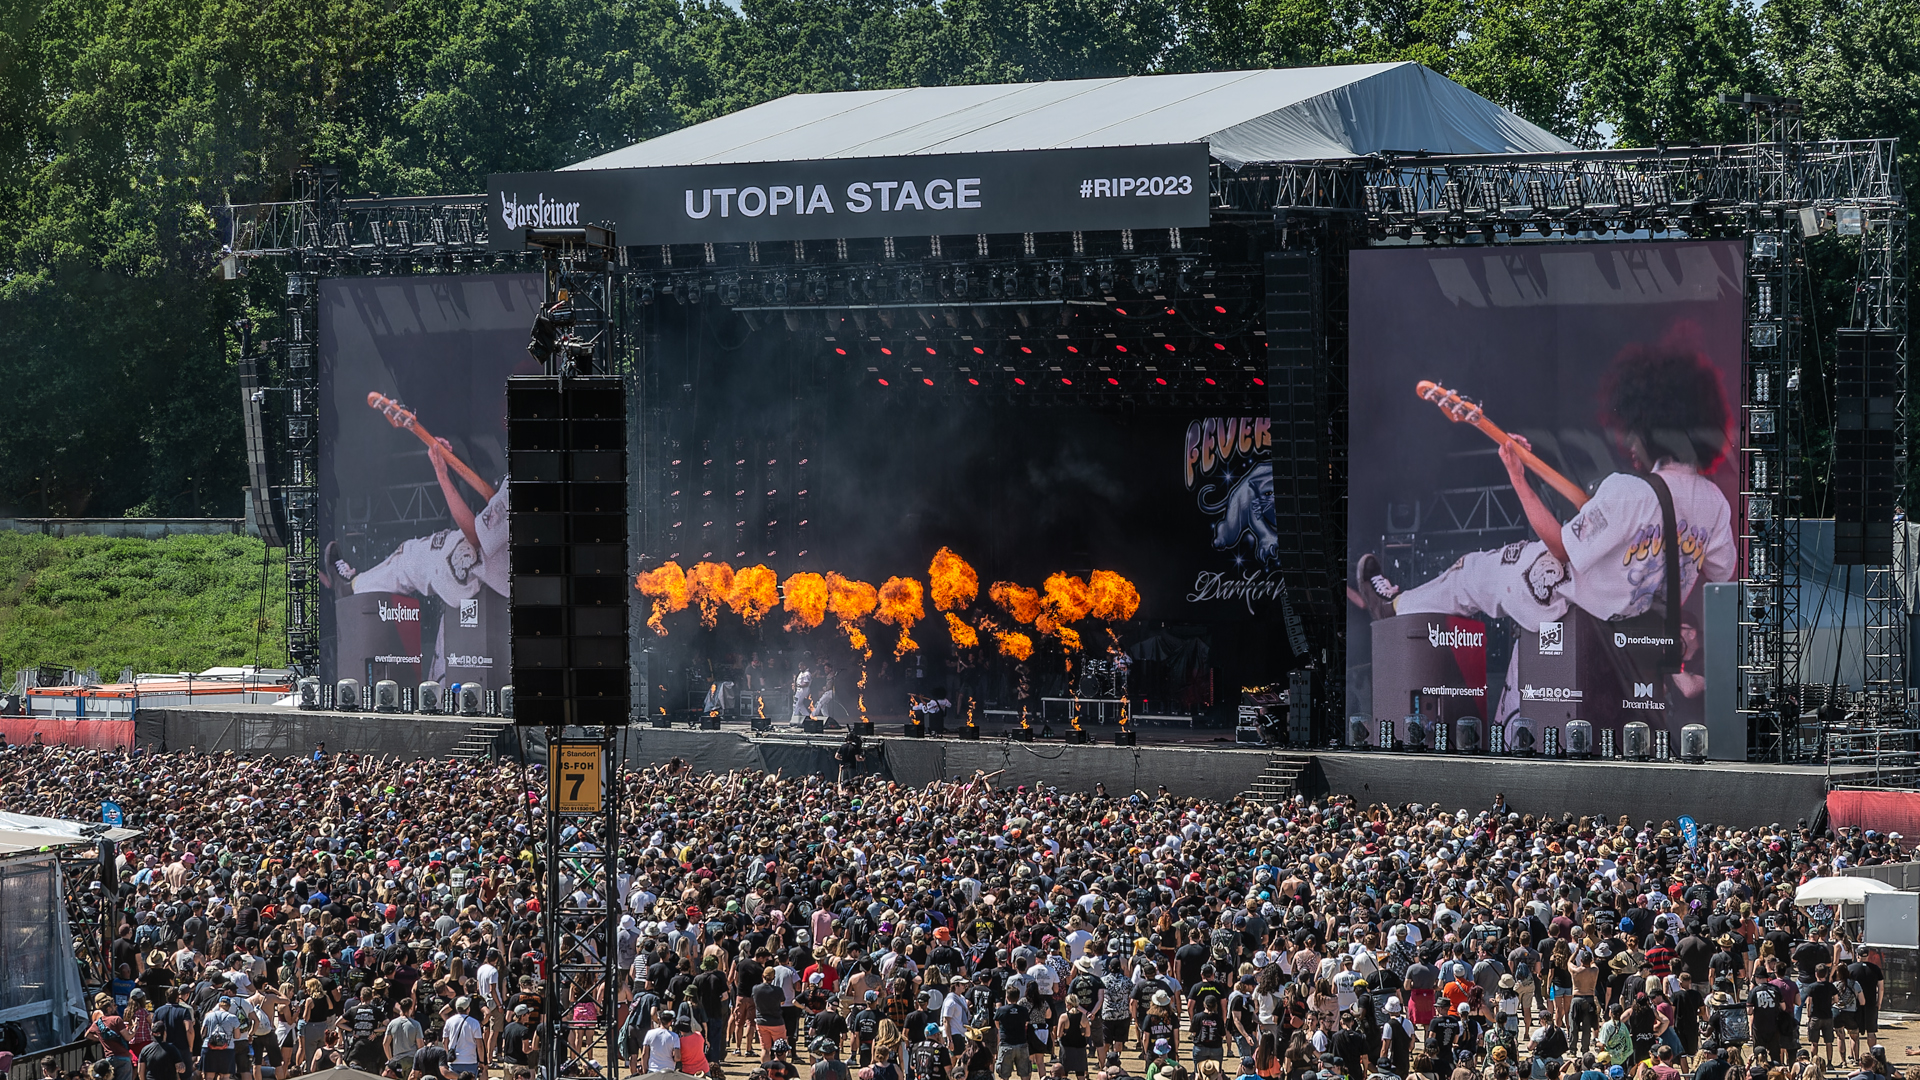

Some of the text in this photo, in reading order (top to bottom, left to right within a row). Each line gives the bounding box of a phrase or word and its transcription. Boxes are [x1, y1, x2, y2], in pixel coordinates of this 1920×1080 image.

[1080, 175, 1193, 198] #RIP2023
[685, 177, 982, 219] UTOPIA STAGE
[1627, 636, 1674, 647] nordbayern
[375, 653, 421, 665] eventimpresents
[459, 655, 484, 665] ARGO
[1422, 684, 1485, 697] eventimpresents
[1539, 687, 1571, 699] ARGO
[1622, 699, 1665, 710] DreamHaus
[561, 761, 594, 770] S-FOH
[565, 773, 585, 801] 7
